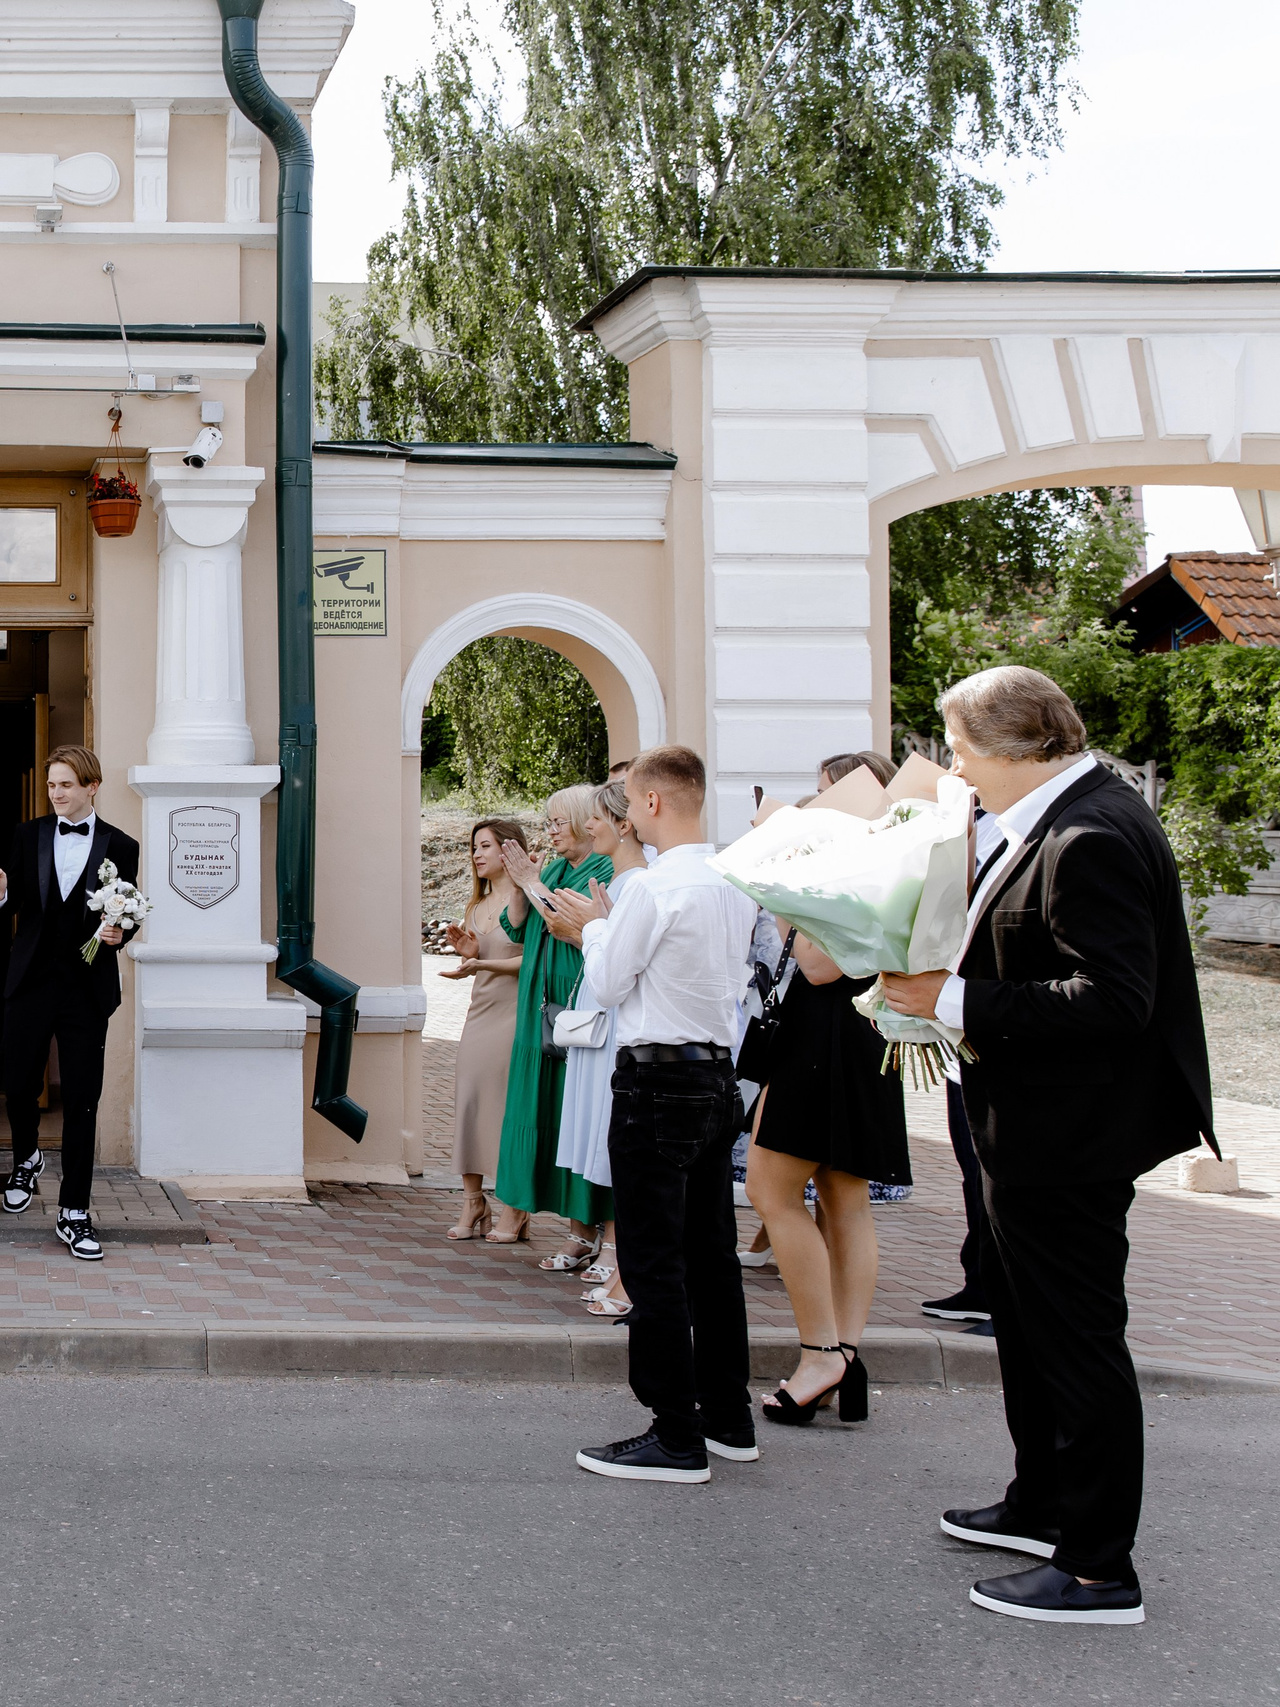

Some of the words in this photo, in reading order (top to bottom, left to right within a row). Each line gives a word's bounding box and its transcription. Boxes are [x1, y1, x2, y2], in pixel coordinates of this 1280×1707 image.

[321, 599, 381, 608] ТЕРРИТОРИИ
[323, 609, 362, 620] ВЕДЁТСЯ
[313, 621, 384, 630] ДЕОНАБЛЮДЕНИЕ
